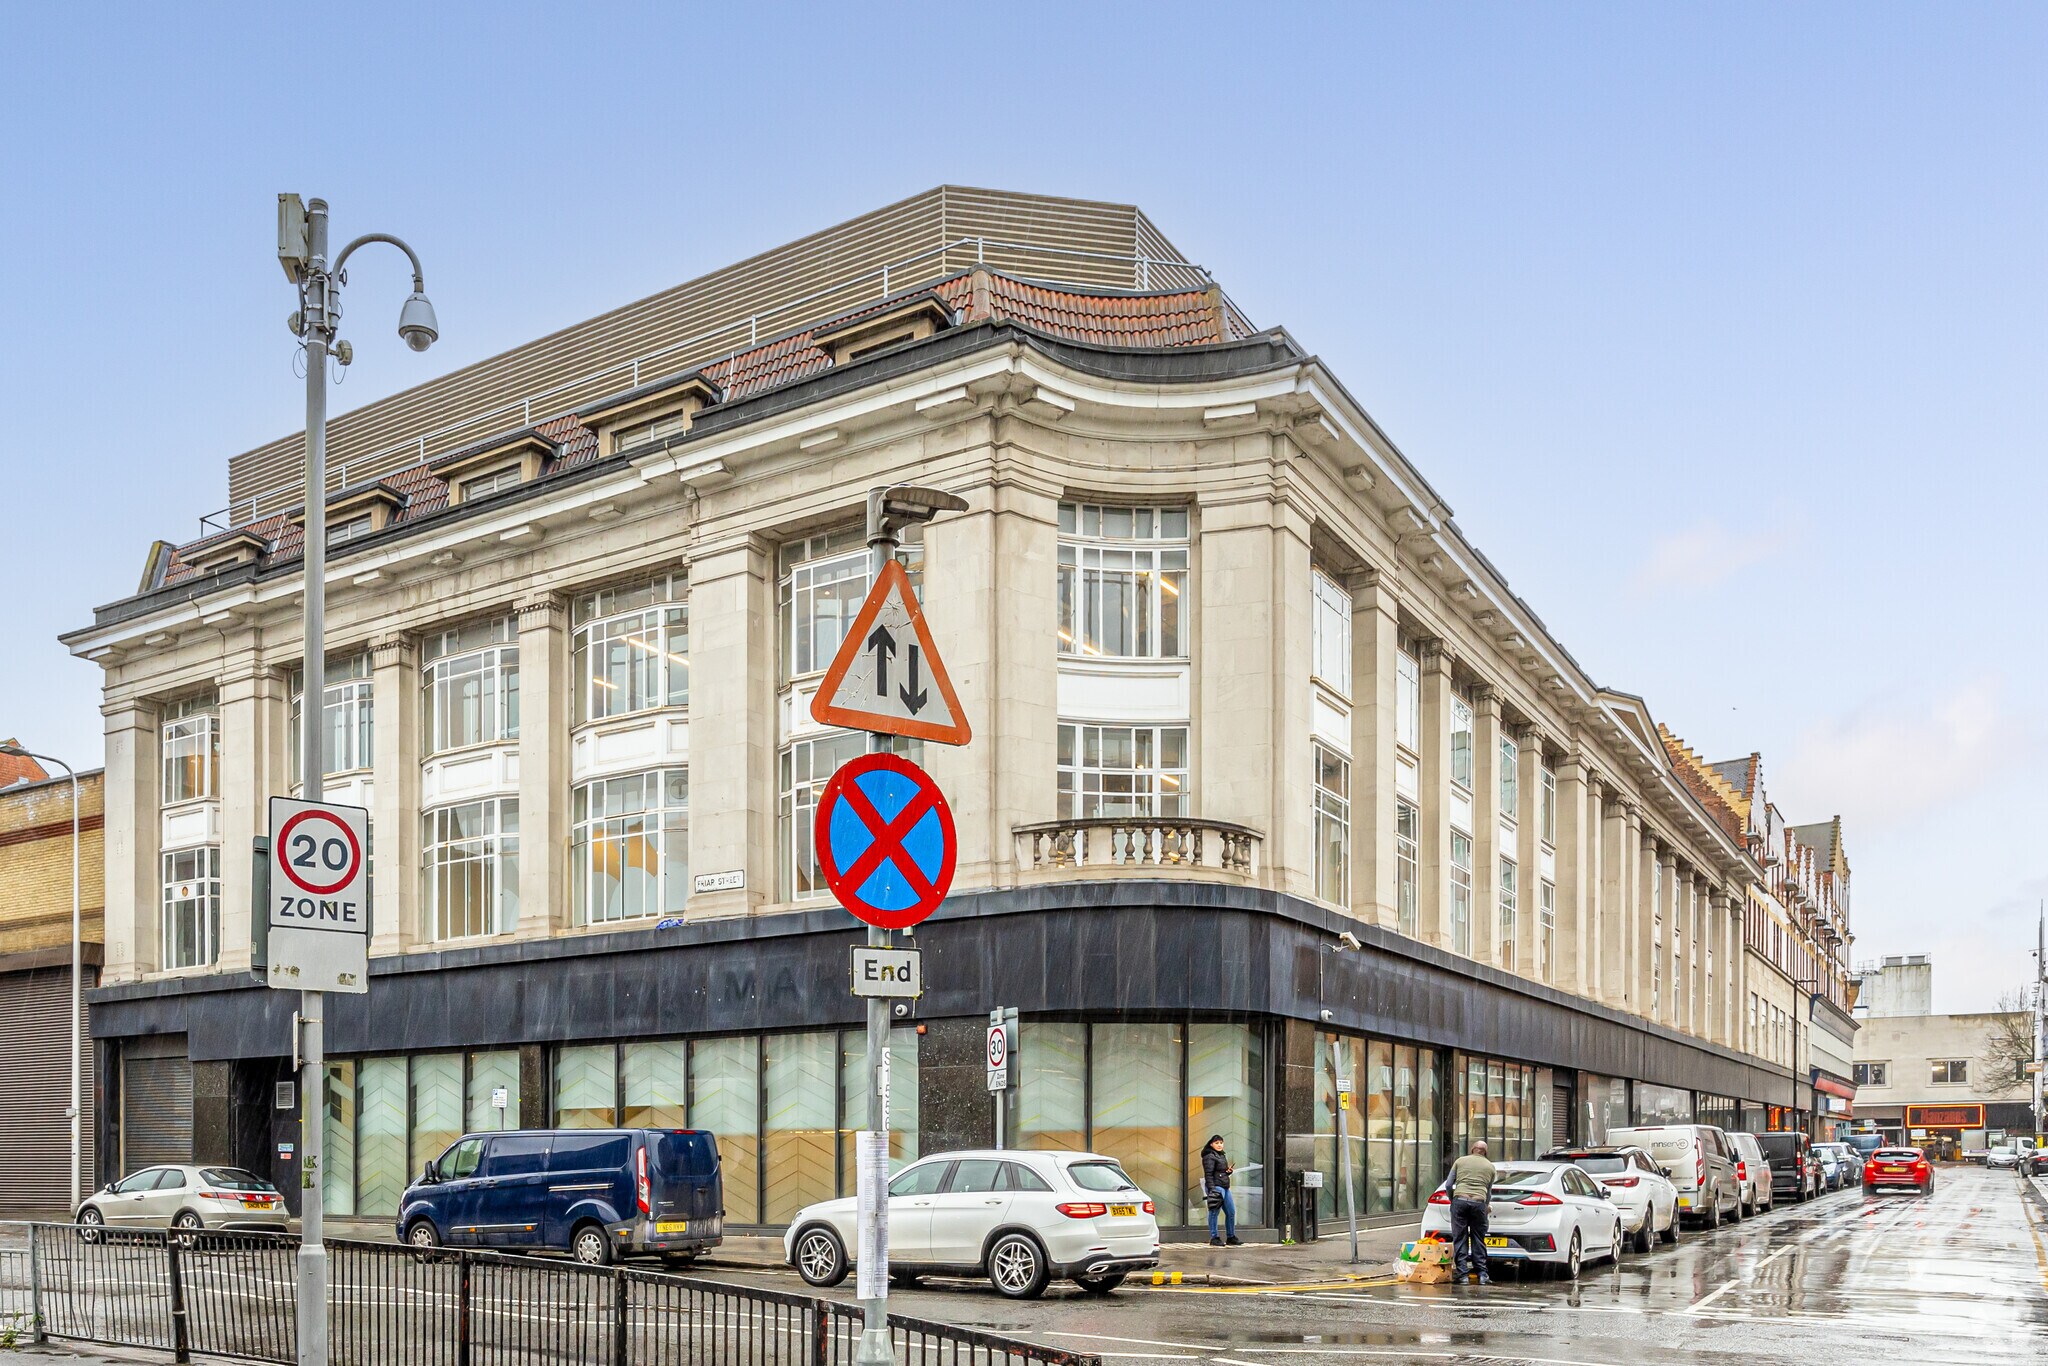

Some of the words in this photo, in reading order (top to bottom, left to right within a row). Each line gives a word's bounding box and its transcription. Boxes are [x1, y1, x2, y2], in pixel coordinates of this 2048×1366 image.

[292, 834, 349, 871] 20
[279, 896, 357, 923] ZONE
[864, 958, 912, 983] End
[990, 1039, 1003, 1056] 30
[1486, 1238, 1503, 1246] ZWT
